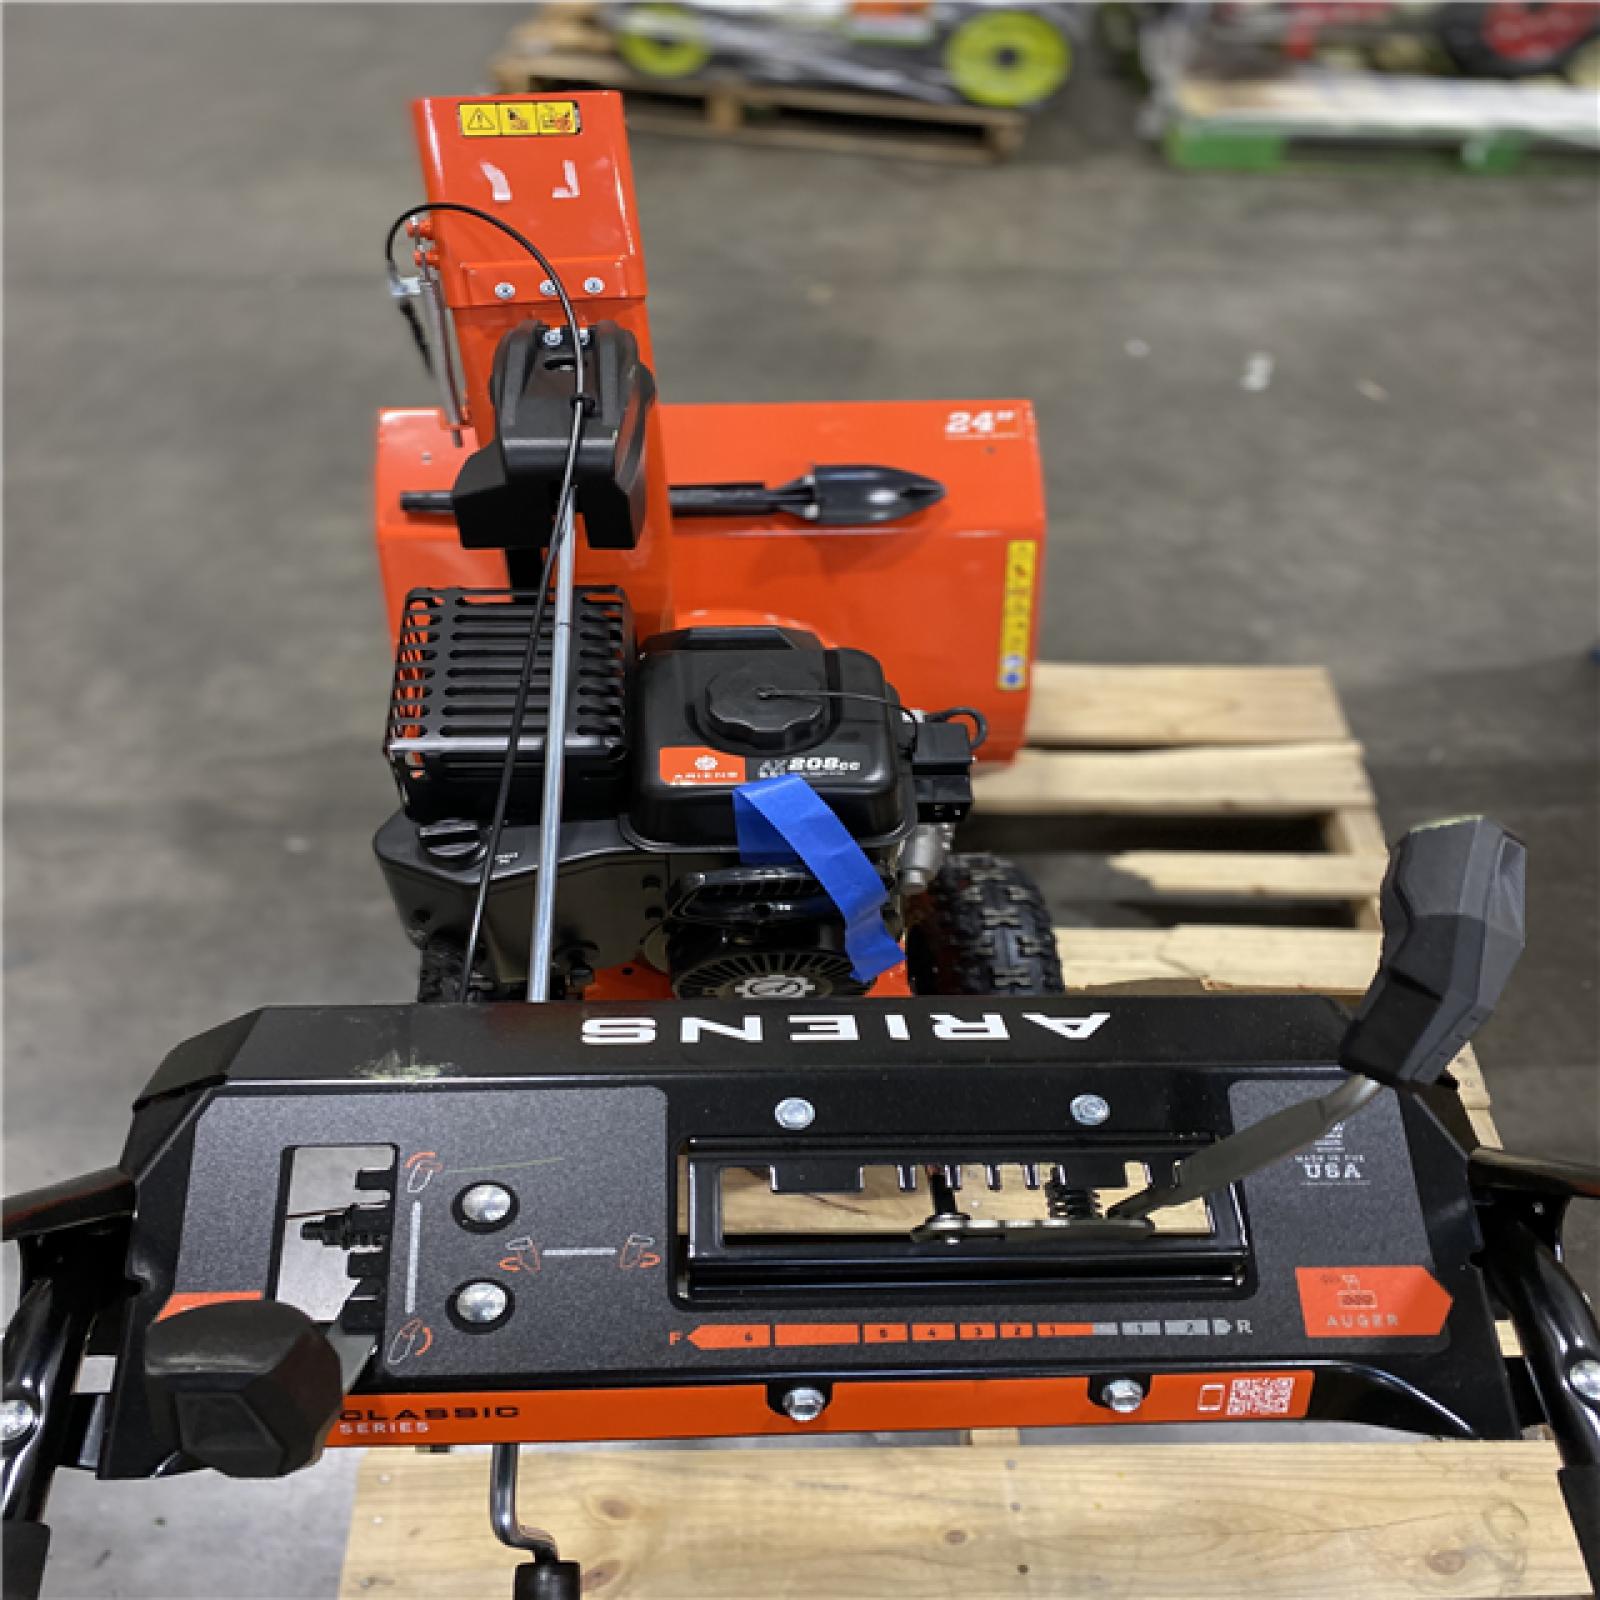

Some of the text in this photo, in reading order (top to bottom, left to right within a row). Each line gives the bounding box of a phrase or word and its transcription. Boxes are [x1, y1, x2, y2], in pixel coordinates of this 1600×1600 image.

[581, 1012, 1111, 1044] ARIENS
[1304, 1162, 1362, 1179] USA
[1326, 1313, 1399, 1329] AUGER
[669, 1331, 683, 1346] F
[927, 1326, 937, 1338] 4
[1236, 1319, 1253, 1335] R
[339, 1406, 519, 1421] CLASSIC
[339, 1421, 430, 1433] SERIES
